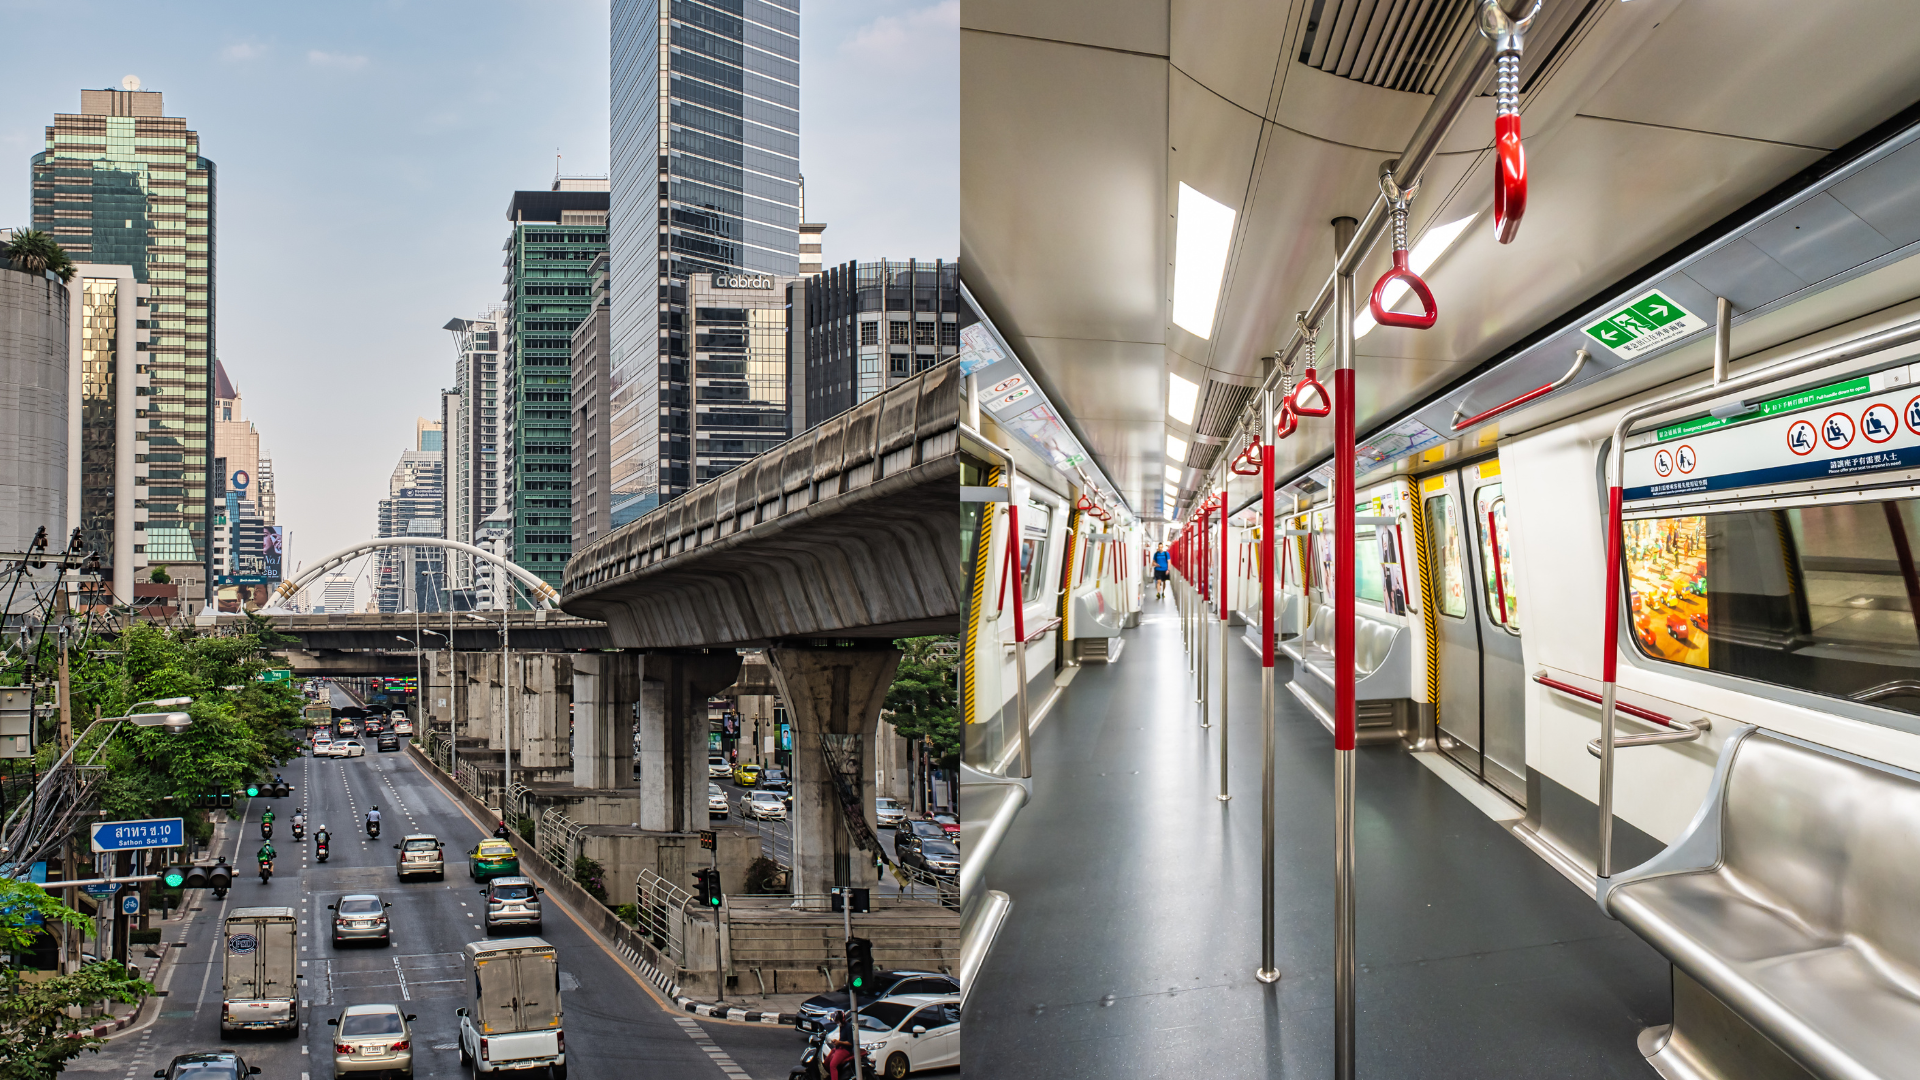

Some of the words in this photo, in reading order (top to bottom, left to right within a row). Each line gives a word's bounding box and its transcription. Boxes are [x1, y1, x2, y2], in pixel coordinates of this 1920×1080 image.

[1623, 320, 1686, 351] 緊急出口在列車兩端
[1824, 391, 1837, 399] handle
[1855, 384, 1866, 392] open
[1683, 425, 1701, 433] Emergency
[1702, 420, 1720, 428] ventilation
[1830, 452, 1898, 469] 請讓座予有需要人士
[115, 826, 147, 838] สาทร
[146, 837, 157, 845] Soi
